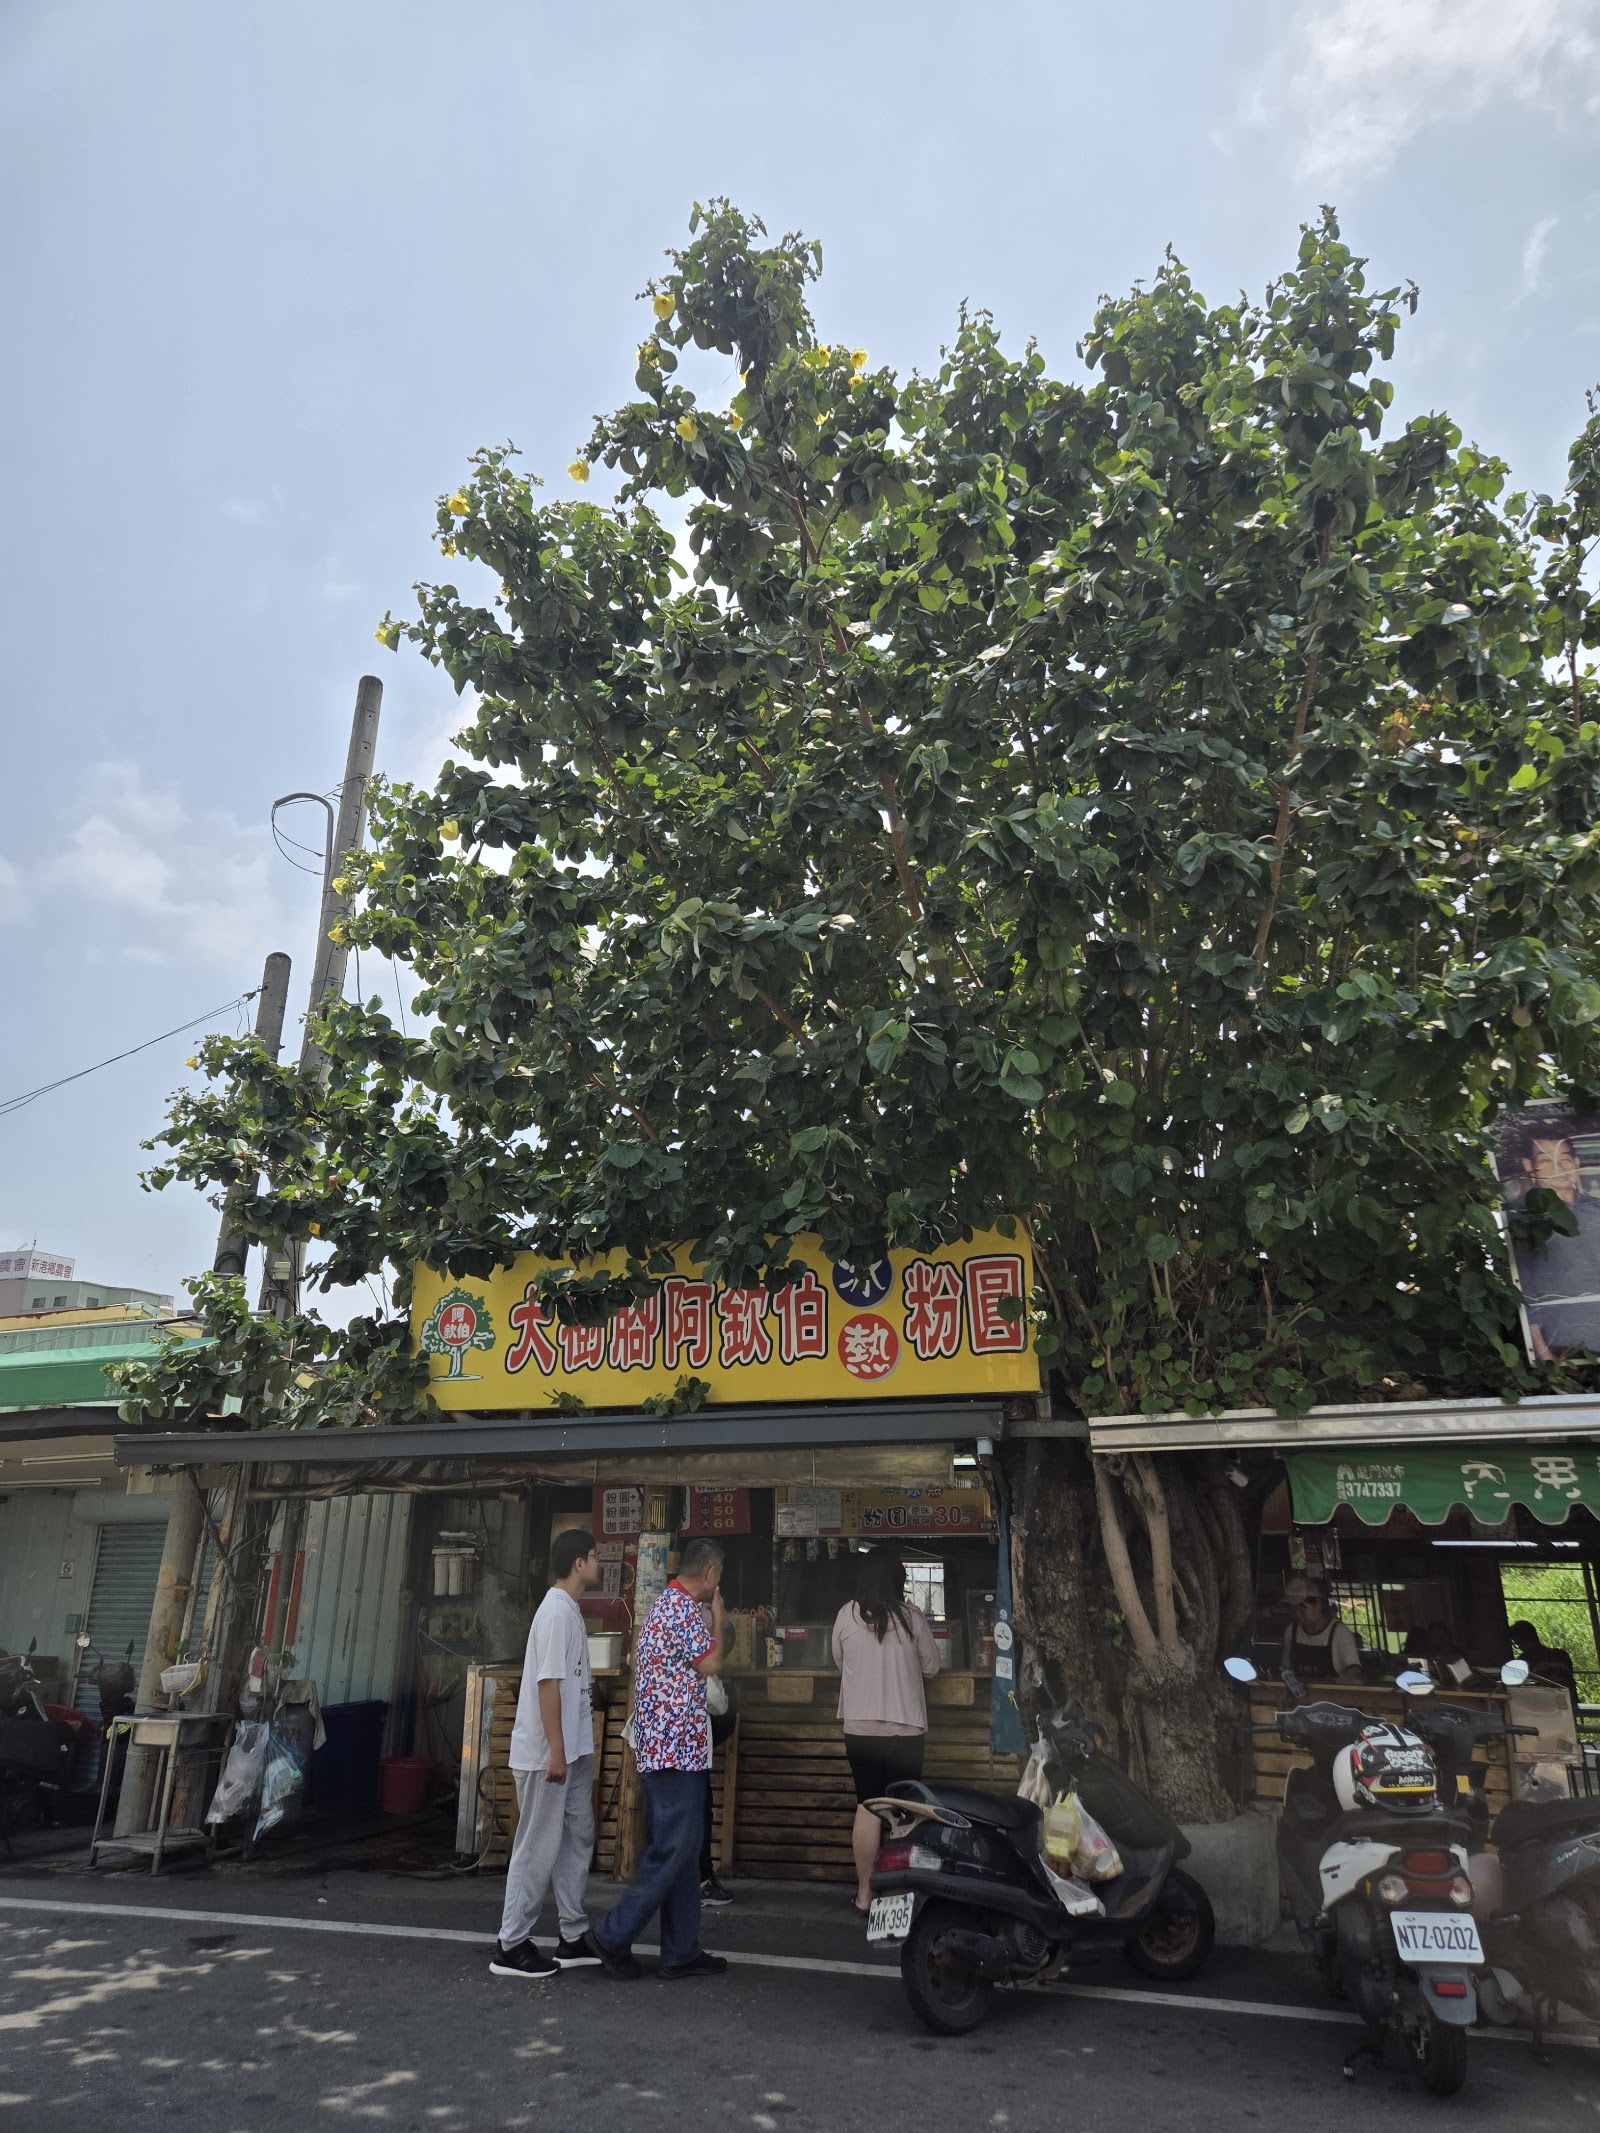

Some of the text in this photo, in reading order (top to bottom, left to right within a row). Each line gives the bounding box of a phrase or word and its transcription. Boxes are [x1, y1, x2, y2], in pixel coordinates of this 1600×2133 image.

[31, 1258, 72, 1278] 新港鄉農會
[844, 1322, 890, 1374] 熱
[902, 1253, 1027, 1361] 粉圓
[443, 1322, 470, 1340] 欽伯
[1346, 1482, 1401, 1497] 3747337
[605, 1492, 641, 1504] 粉圓+
[701, 1493, 734, 1503] 小 40
[701, 1506, 734, 1516] 中 50
[863, 1505, 908, 1528] 粉圓
[934, 1504, 962, 1526] 30
[701, 1519, 734, 1529] 大 60
